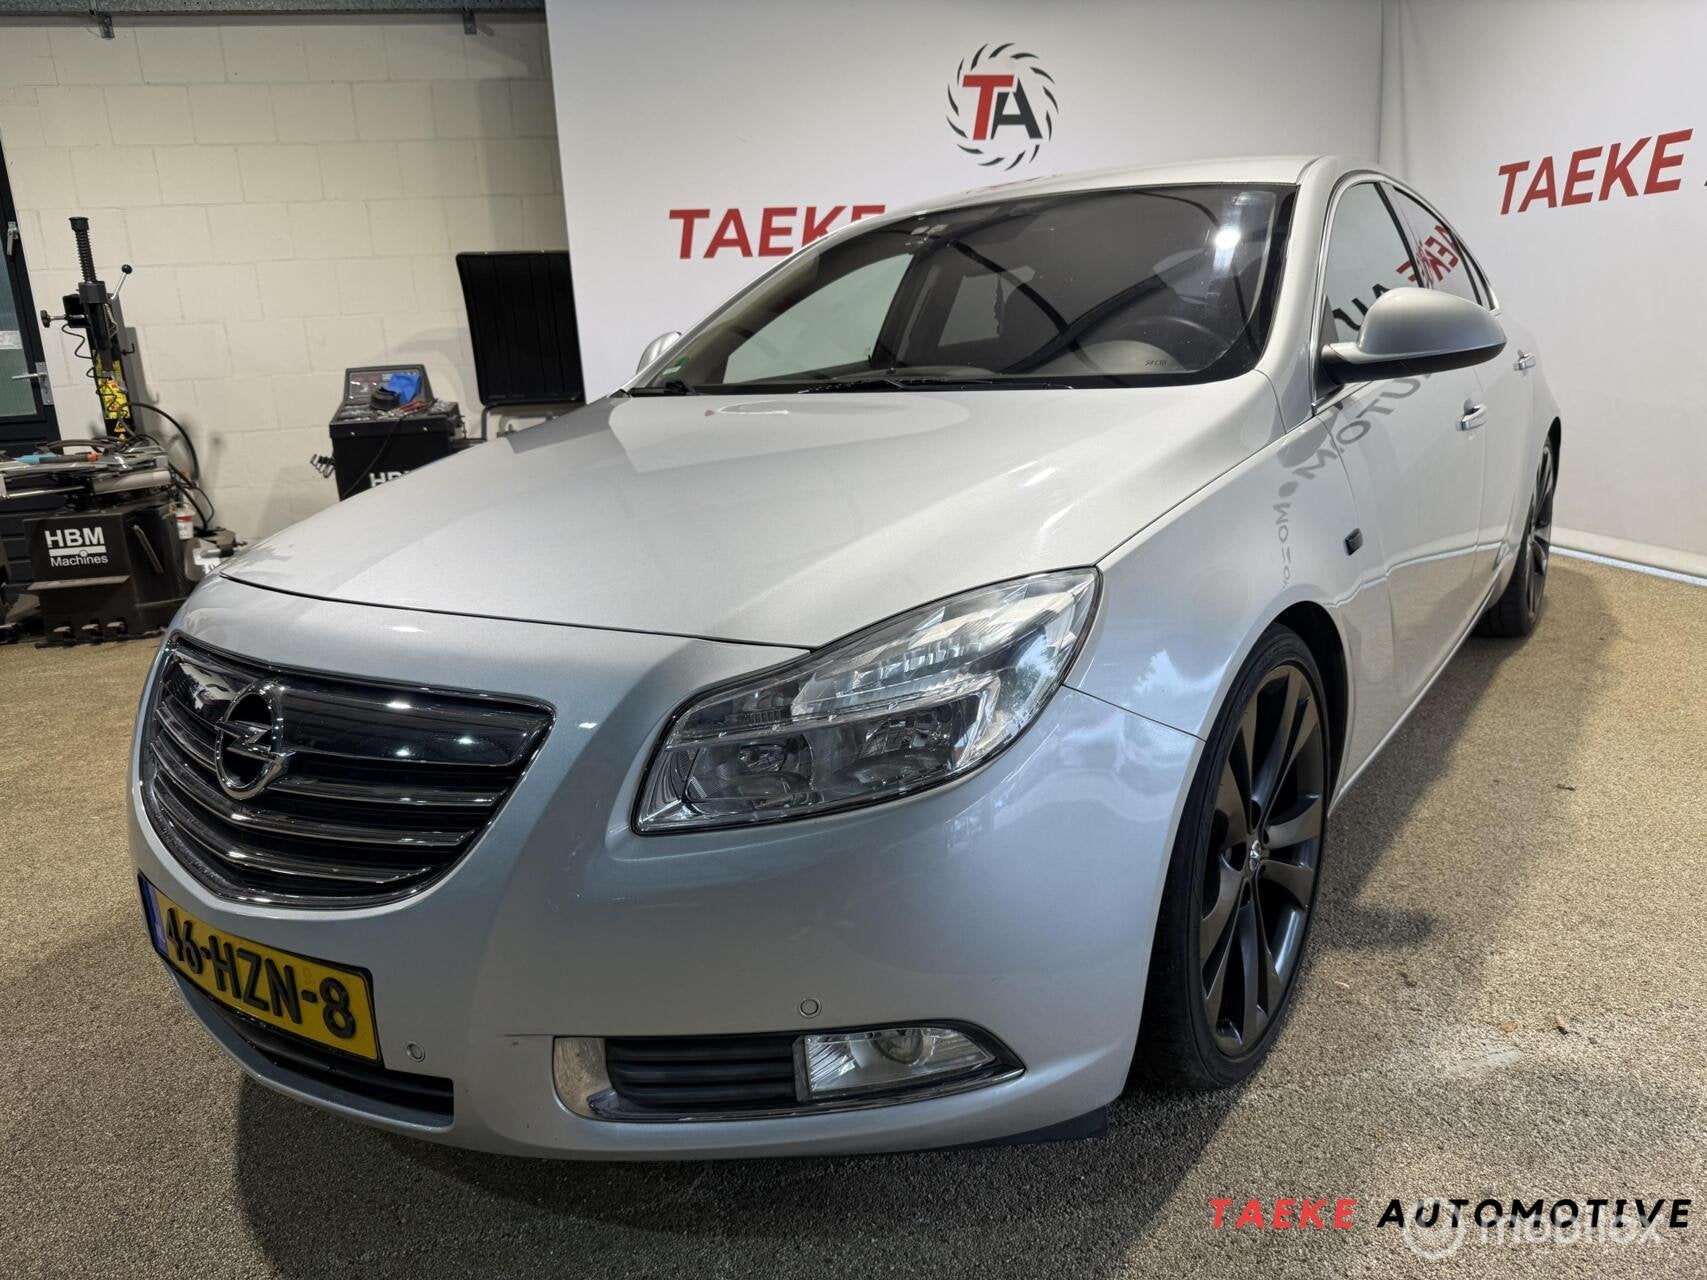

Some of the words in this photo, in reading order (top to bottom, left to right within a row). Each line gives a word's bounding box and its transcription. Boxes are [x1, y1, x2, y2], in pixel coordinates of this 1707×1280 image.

[962, 74, 1043, 141] TA
[1498, 128, 1694, 216] TAEKE
[44, 526, 105, 548] HBM
[50, 555, 109, 568] Machines
[166, 907, 357, 1040] 46-HZN-8
